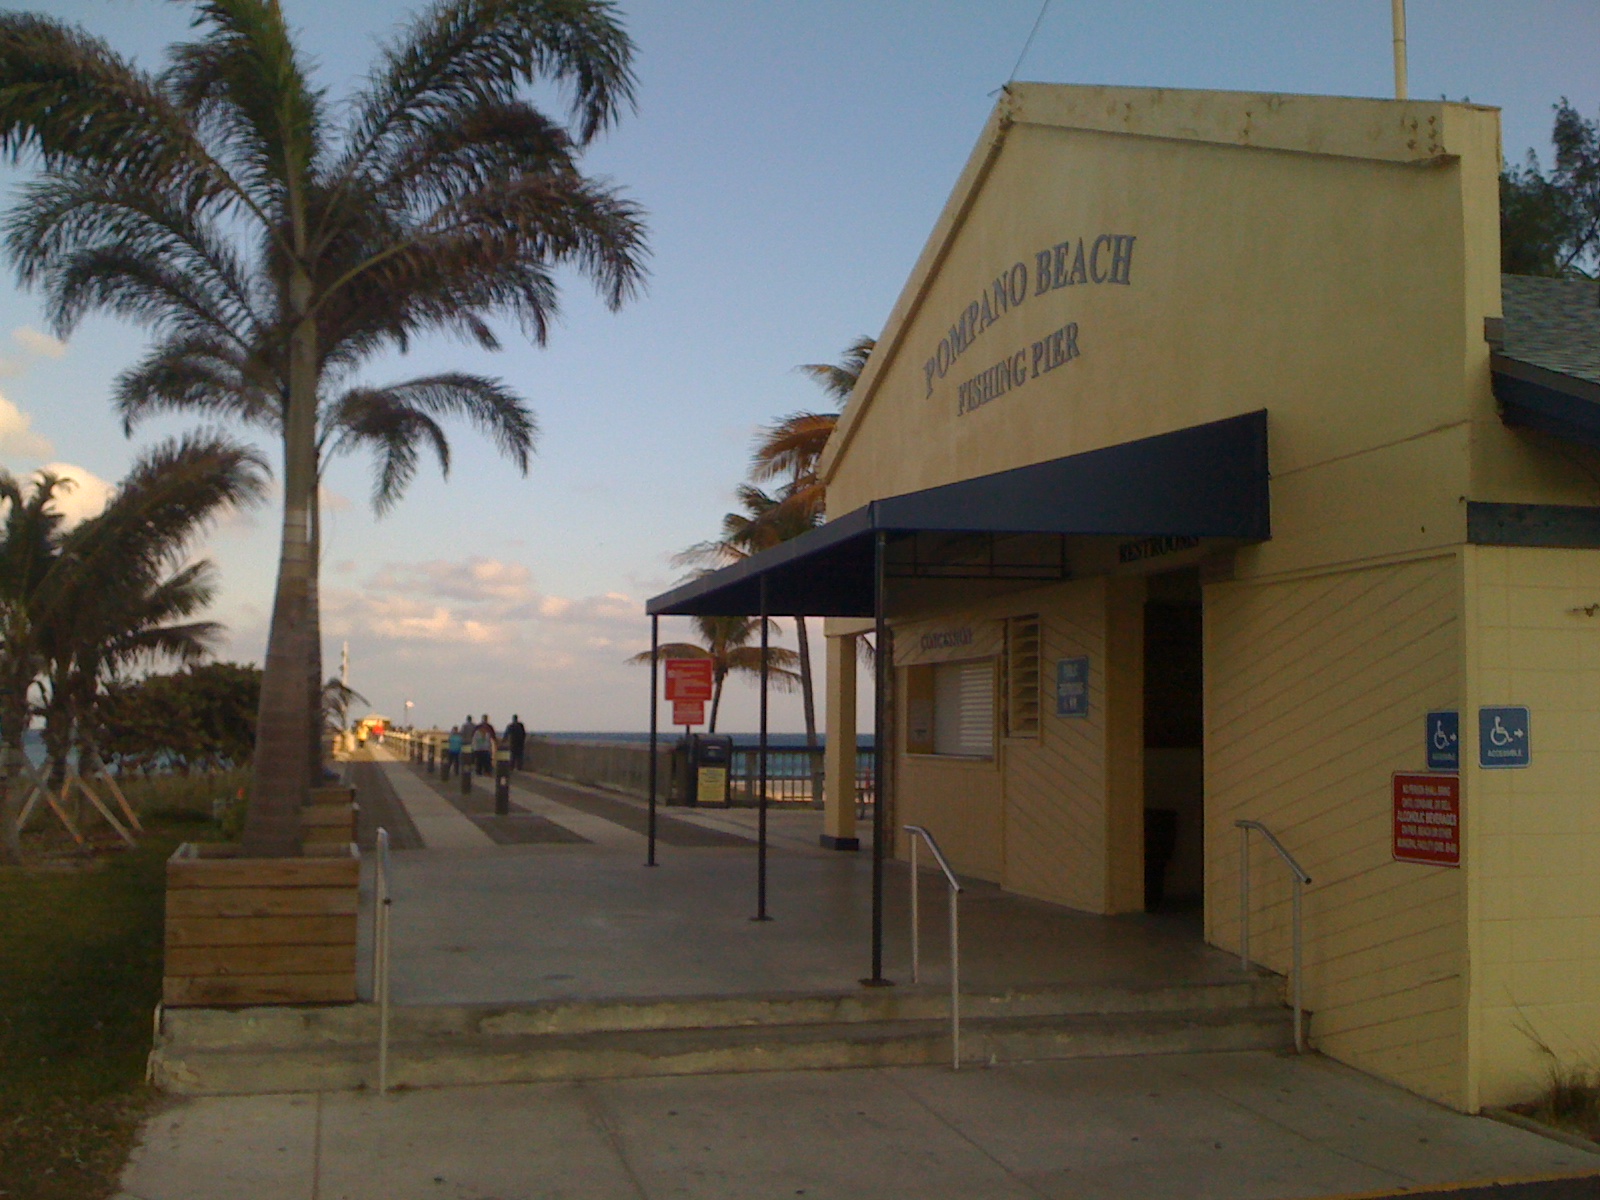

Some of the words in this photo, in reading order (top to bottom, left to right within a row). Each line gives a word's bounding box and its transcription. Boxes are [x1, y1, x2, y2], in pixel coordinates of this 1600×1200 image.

[923, 262, 1027, 400] POMPANO
[1034, 233, 1136, 297] BEACH
[957, 348, 1026, 417] FISHING
[1031, 322, 1080, 379] PIER
